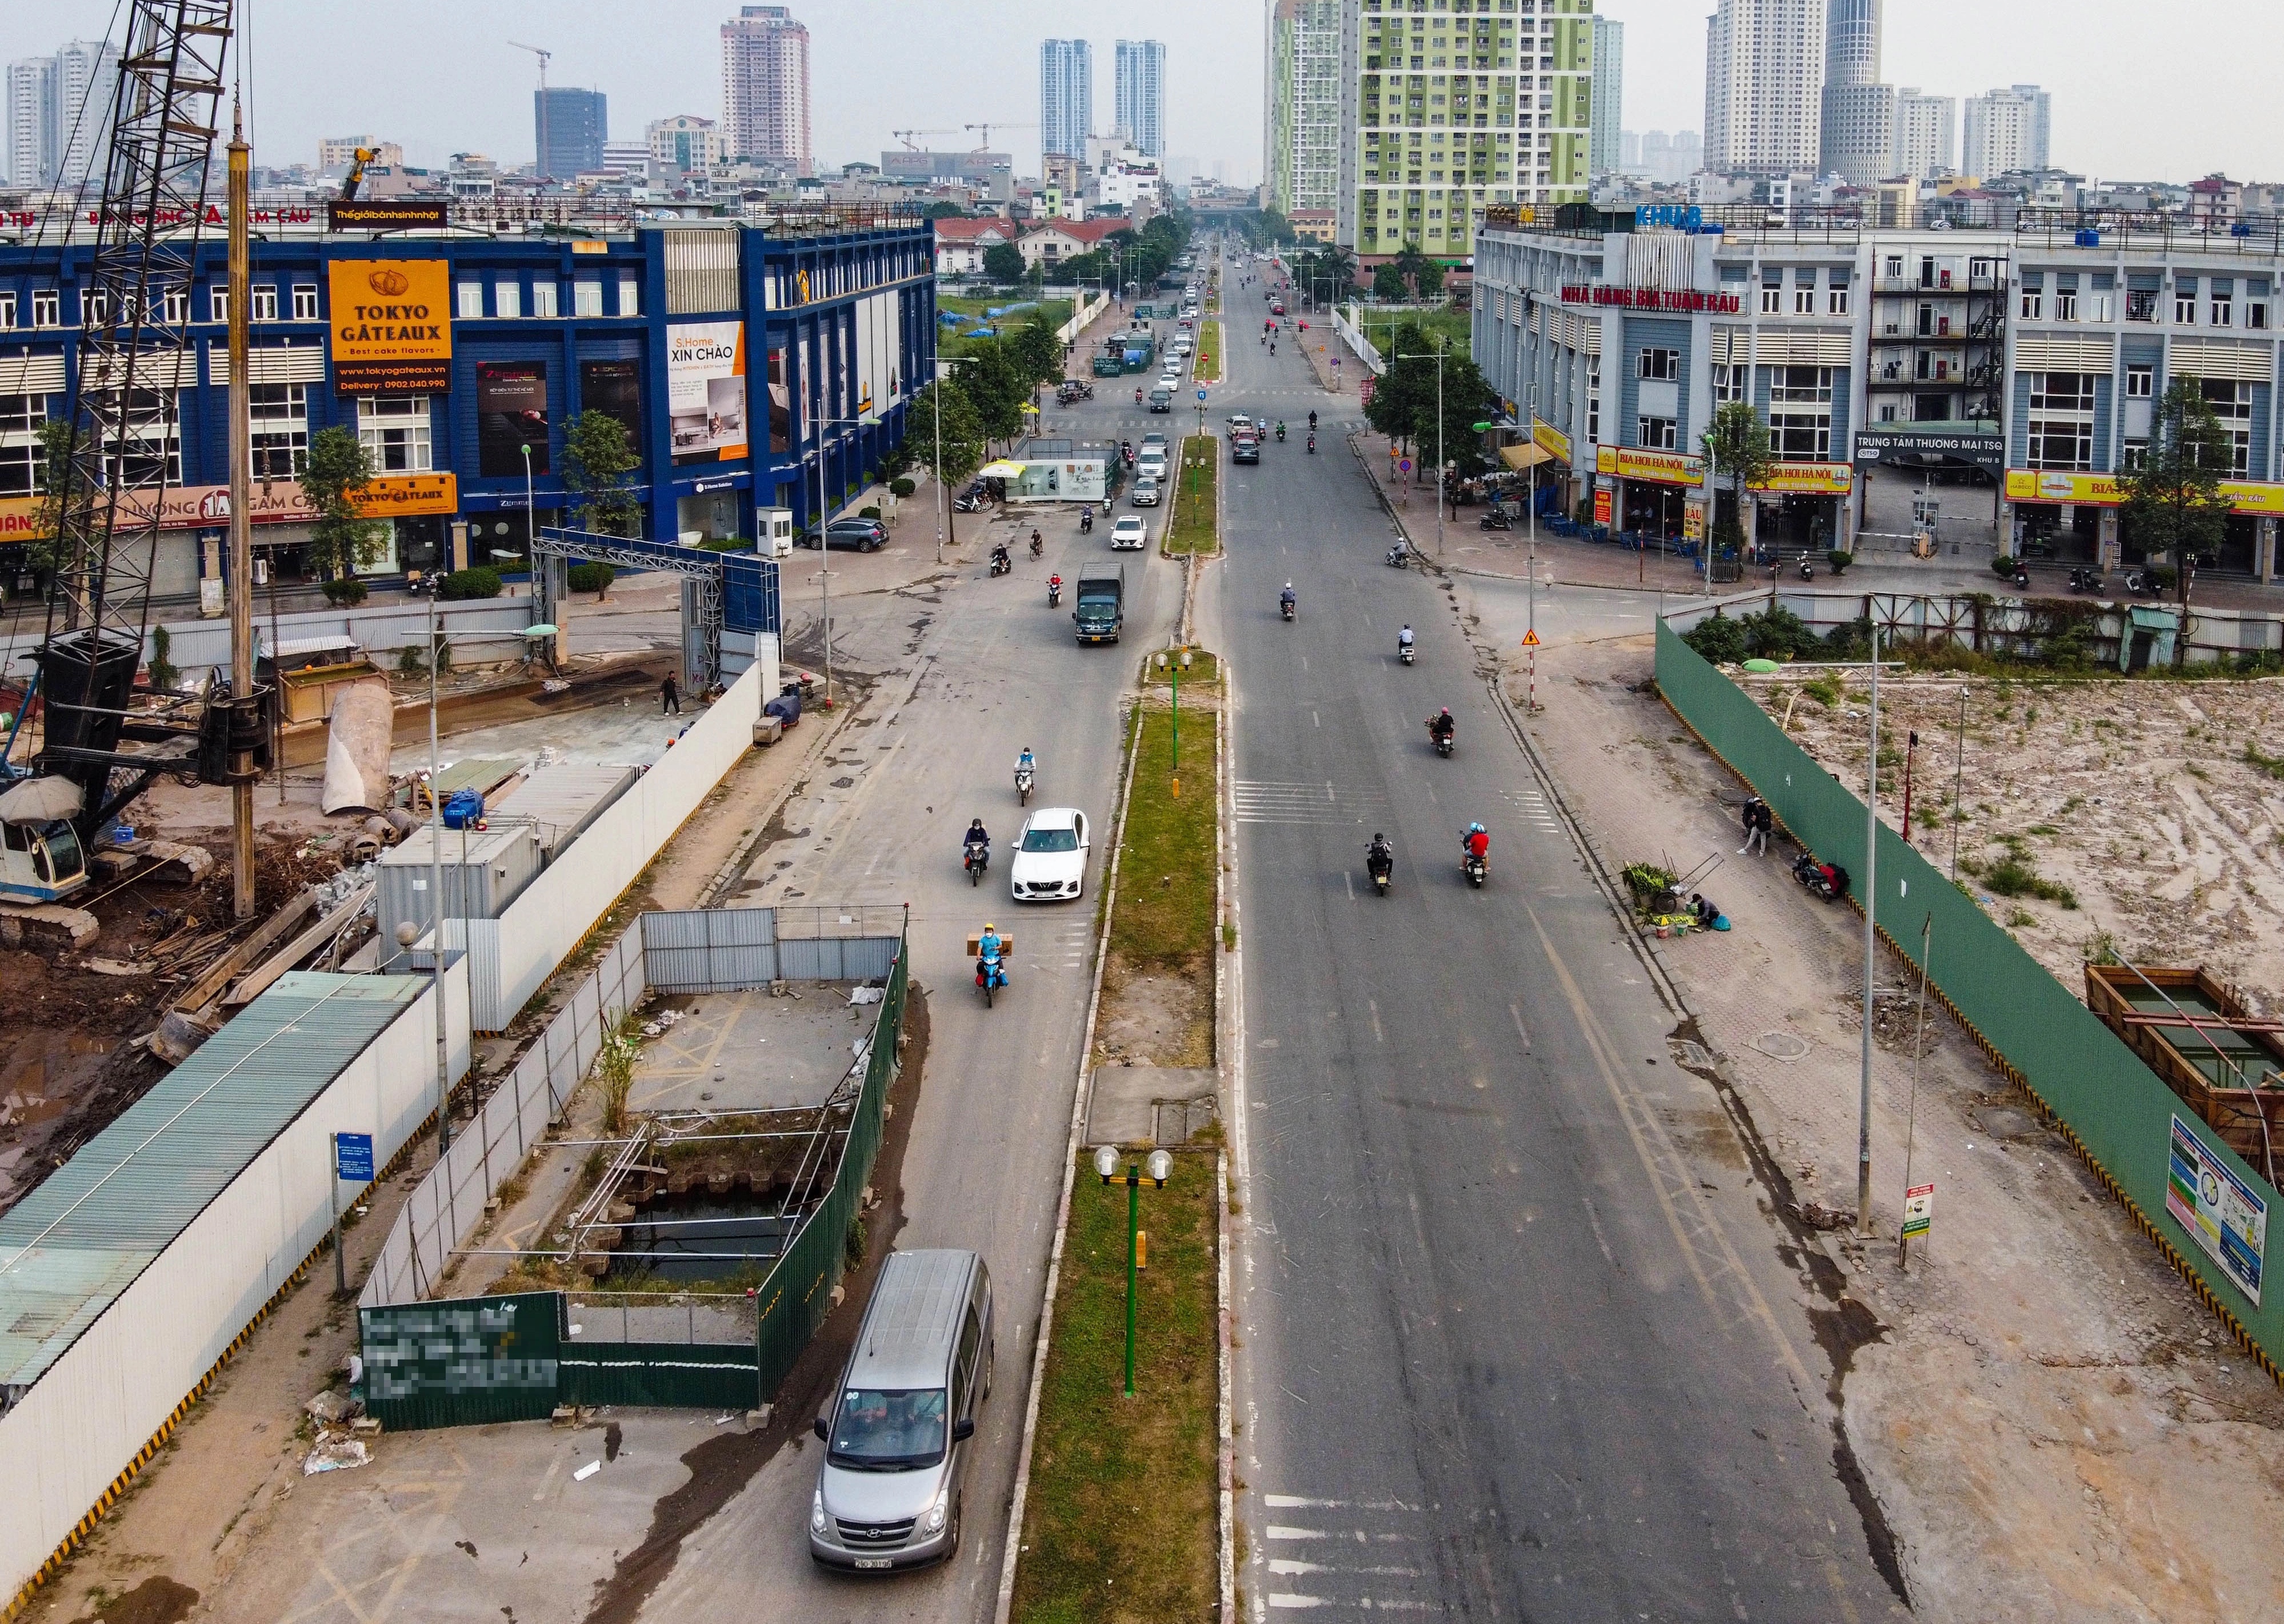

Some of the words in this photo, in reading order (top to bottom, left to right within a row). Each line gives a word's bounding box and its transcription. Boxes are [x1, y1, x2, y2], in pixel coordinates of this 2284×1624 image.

[1635, 205, 1681, 226] KHU
[1688, 206, 1702, 227] B
[1562, 283, 1589, 303] NHÀ
[1593, 285, 1633, 306] HÀNG
[1636, 286, 1661, 308] BIA
[1707, 291, 1739, 313] RÂU
[355, 305, 429, 320] TOKYO
[341, 324, 442, 342] GÂTEAUX
[676, 338, 714, 348] S.Home
[672, 349, 693, 362] XIN
[696, 344, 733, 361] CHÀO
[339, 367, 446, 375] www.tokyogateaux.vn
[341, 382, 382, 390] Delivery:
[385, 380, 445, 389] 0902.040.990
[1858, 437, 1890, 447] TRUNG
[1893, 436, 1914, 448] TÂM
[1917, 438, 1959, 449] THƯƠNG
[1961, 440, 1981, 452] MẠI
[1983, 441, 2003, 451] TSQ
[1619, 454, 1634, 465] BIA
[1635, 456, 1651, 466] HƠI
[1651, 456, 1665, 468] HÀ
[1666, 458, 1683, 471] NỘI
[1769, 468, 1783, 478] BIA
[1784, 469, 1800, 478] HƠI
[1802, 466, 1815, 479] HÀ
[1816, 468, 1831, 481] NỘI
[2091, 483, 2114, 494] BIA
[352, 494, 389, 503] TOKYO
[2247, 494, 2266, 502] RÂU
